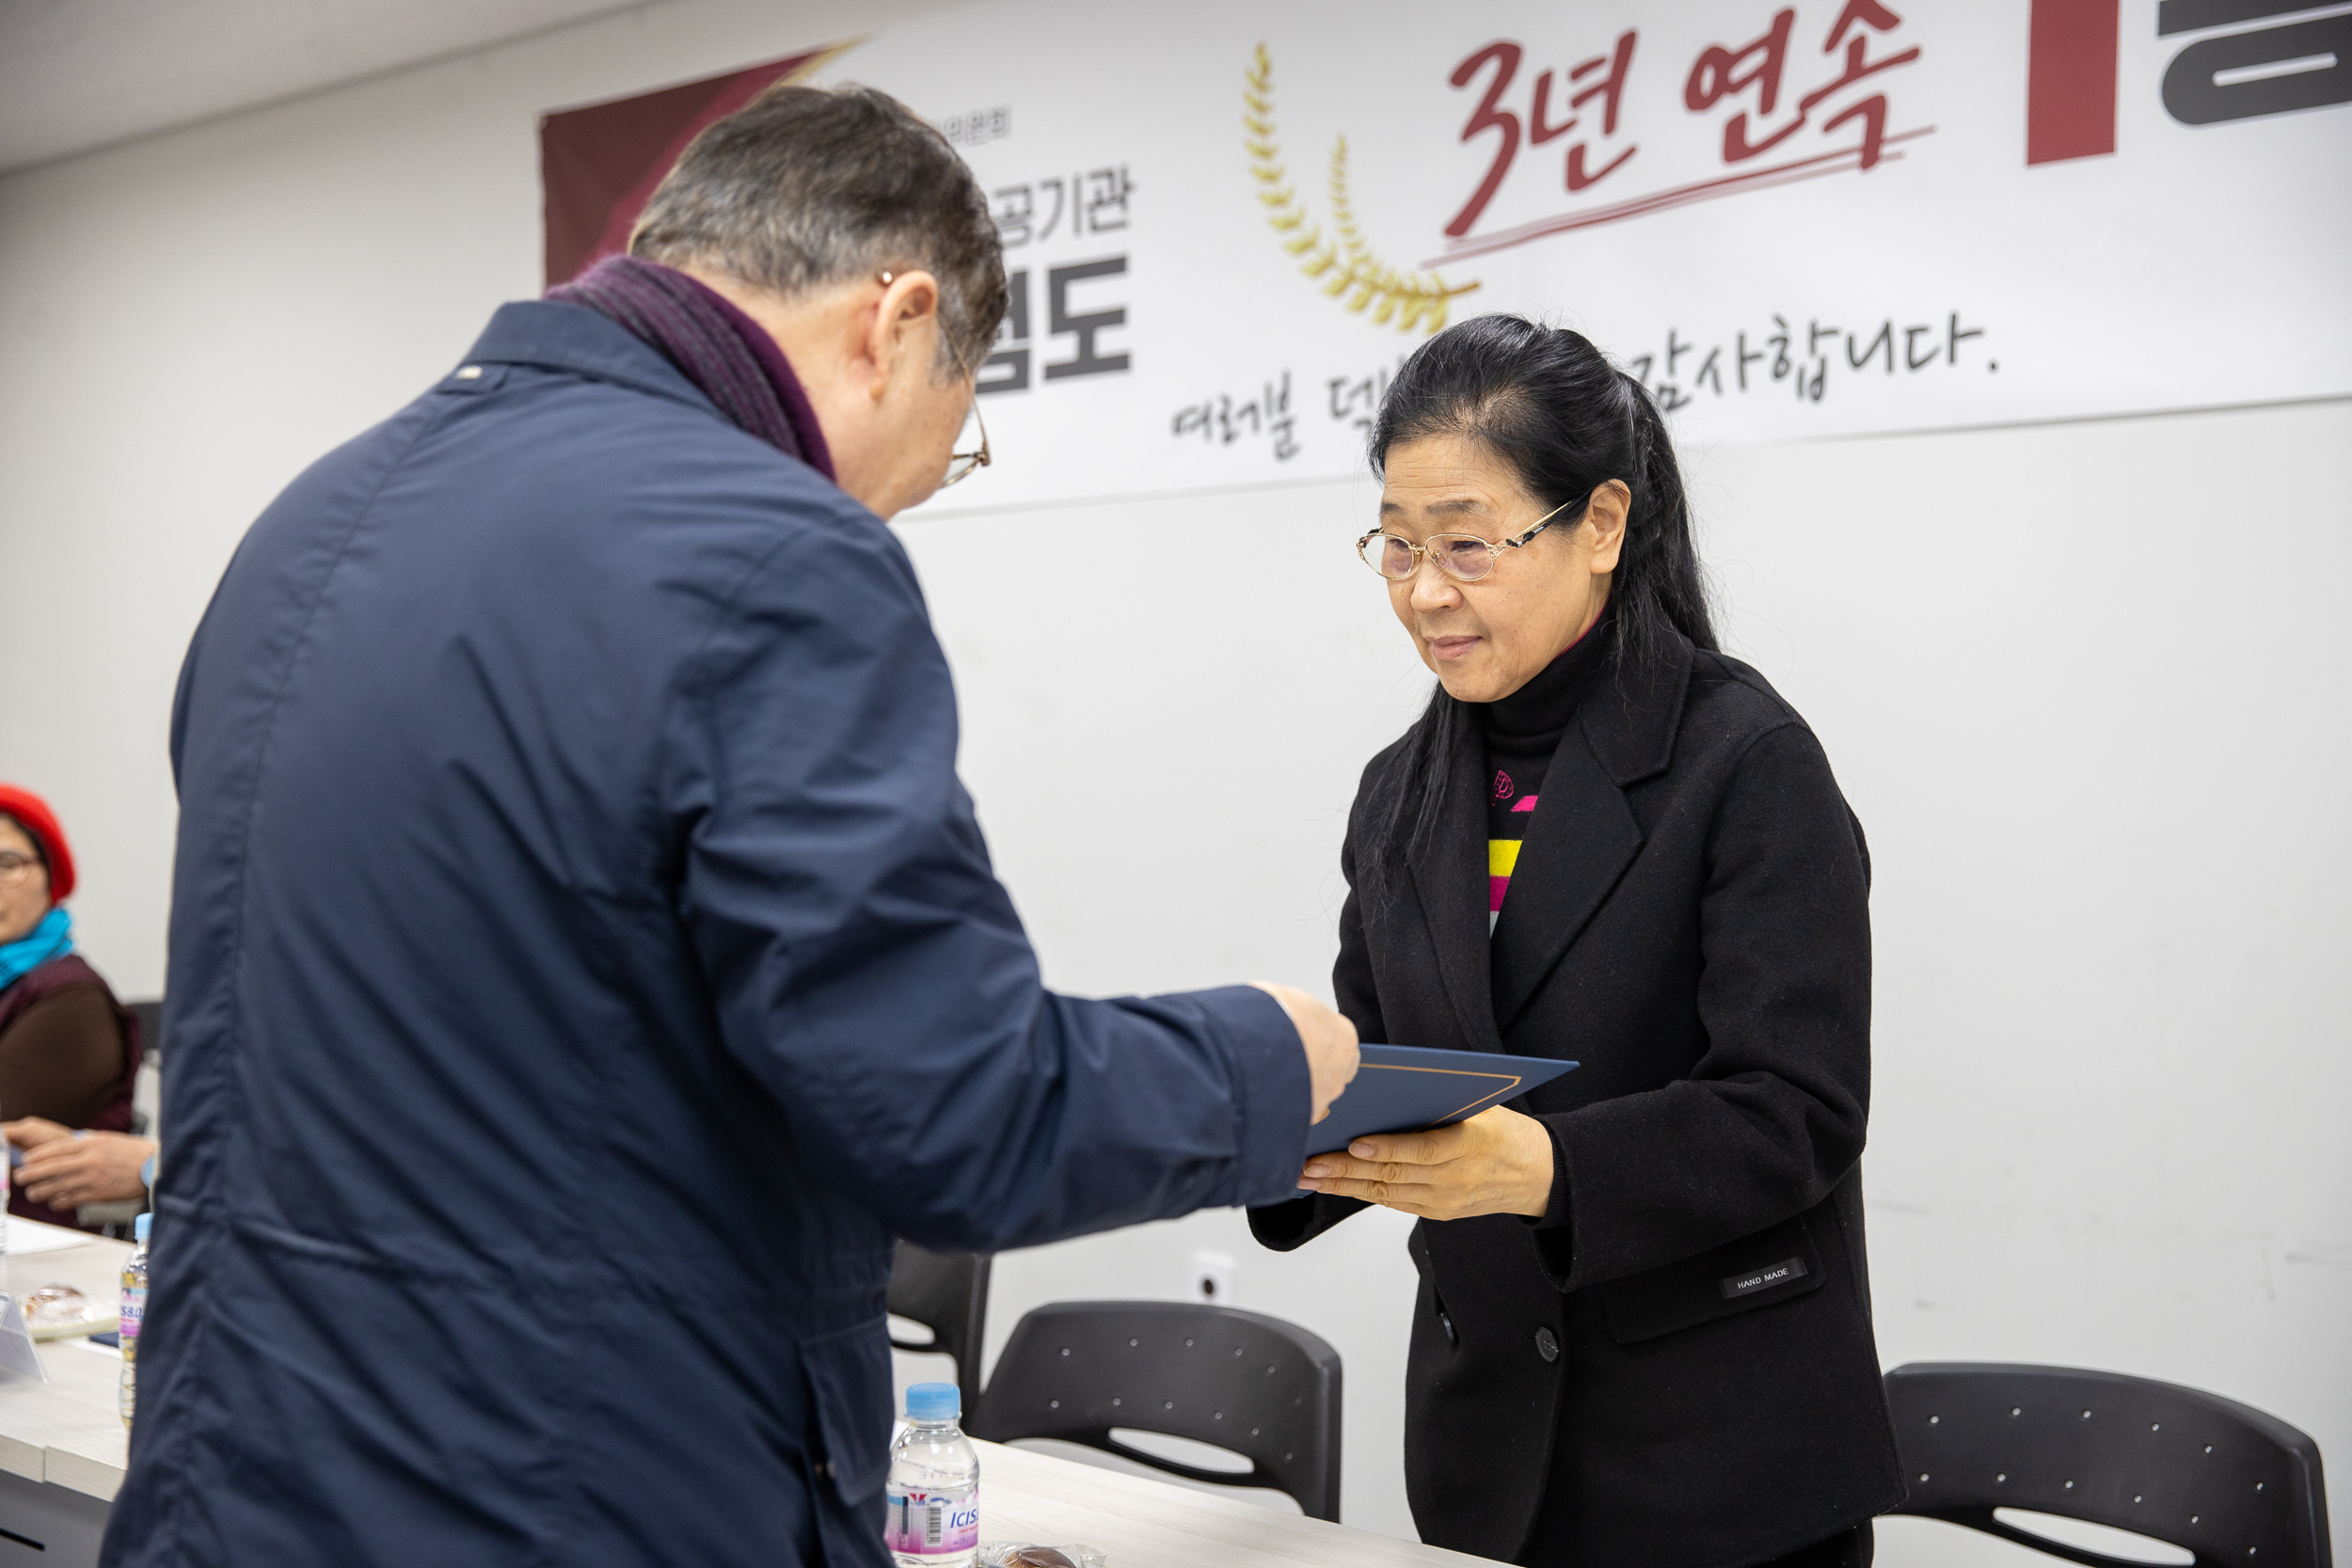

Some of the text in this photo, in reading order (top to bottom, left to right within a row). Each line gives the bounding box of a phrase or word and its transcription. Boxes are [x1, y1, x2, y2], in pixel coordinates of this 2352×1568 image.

[1443, 29, 1639, 237] 3년
[1681, 0, 1922, 172] 연속
[1171, 368, 1301, 463] 여러분
[1737, 1267, 1789, 1290] HAND MADE
[949, 1508, 978, 1528] ICIS
